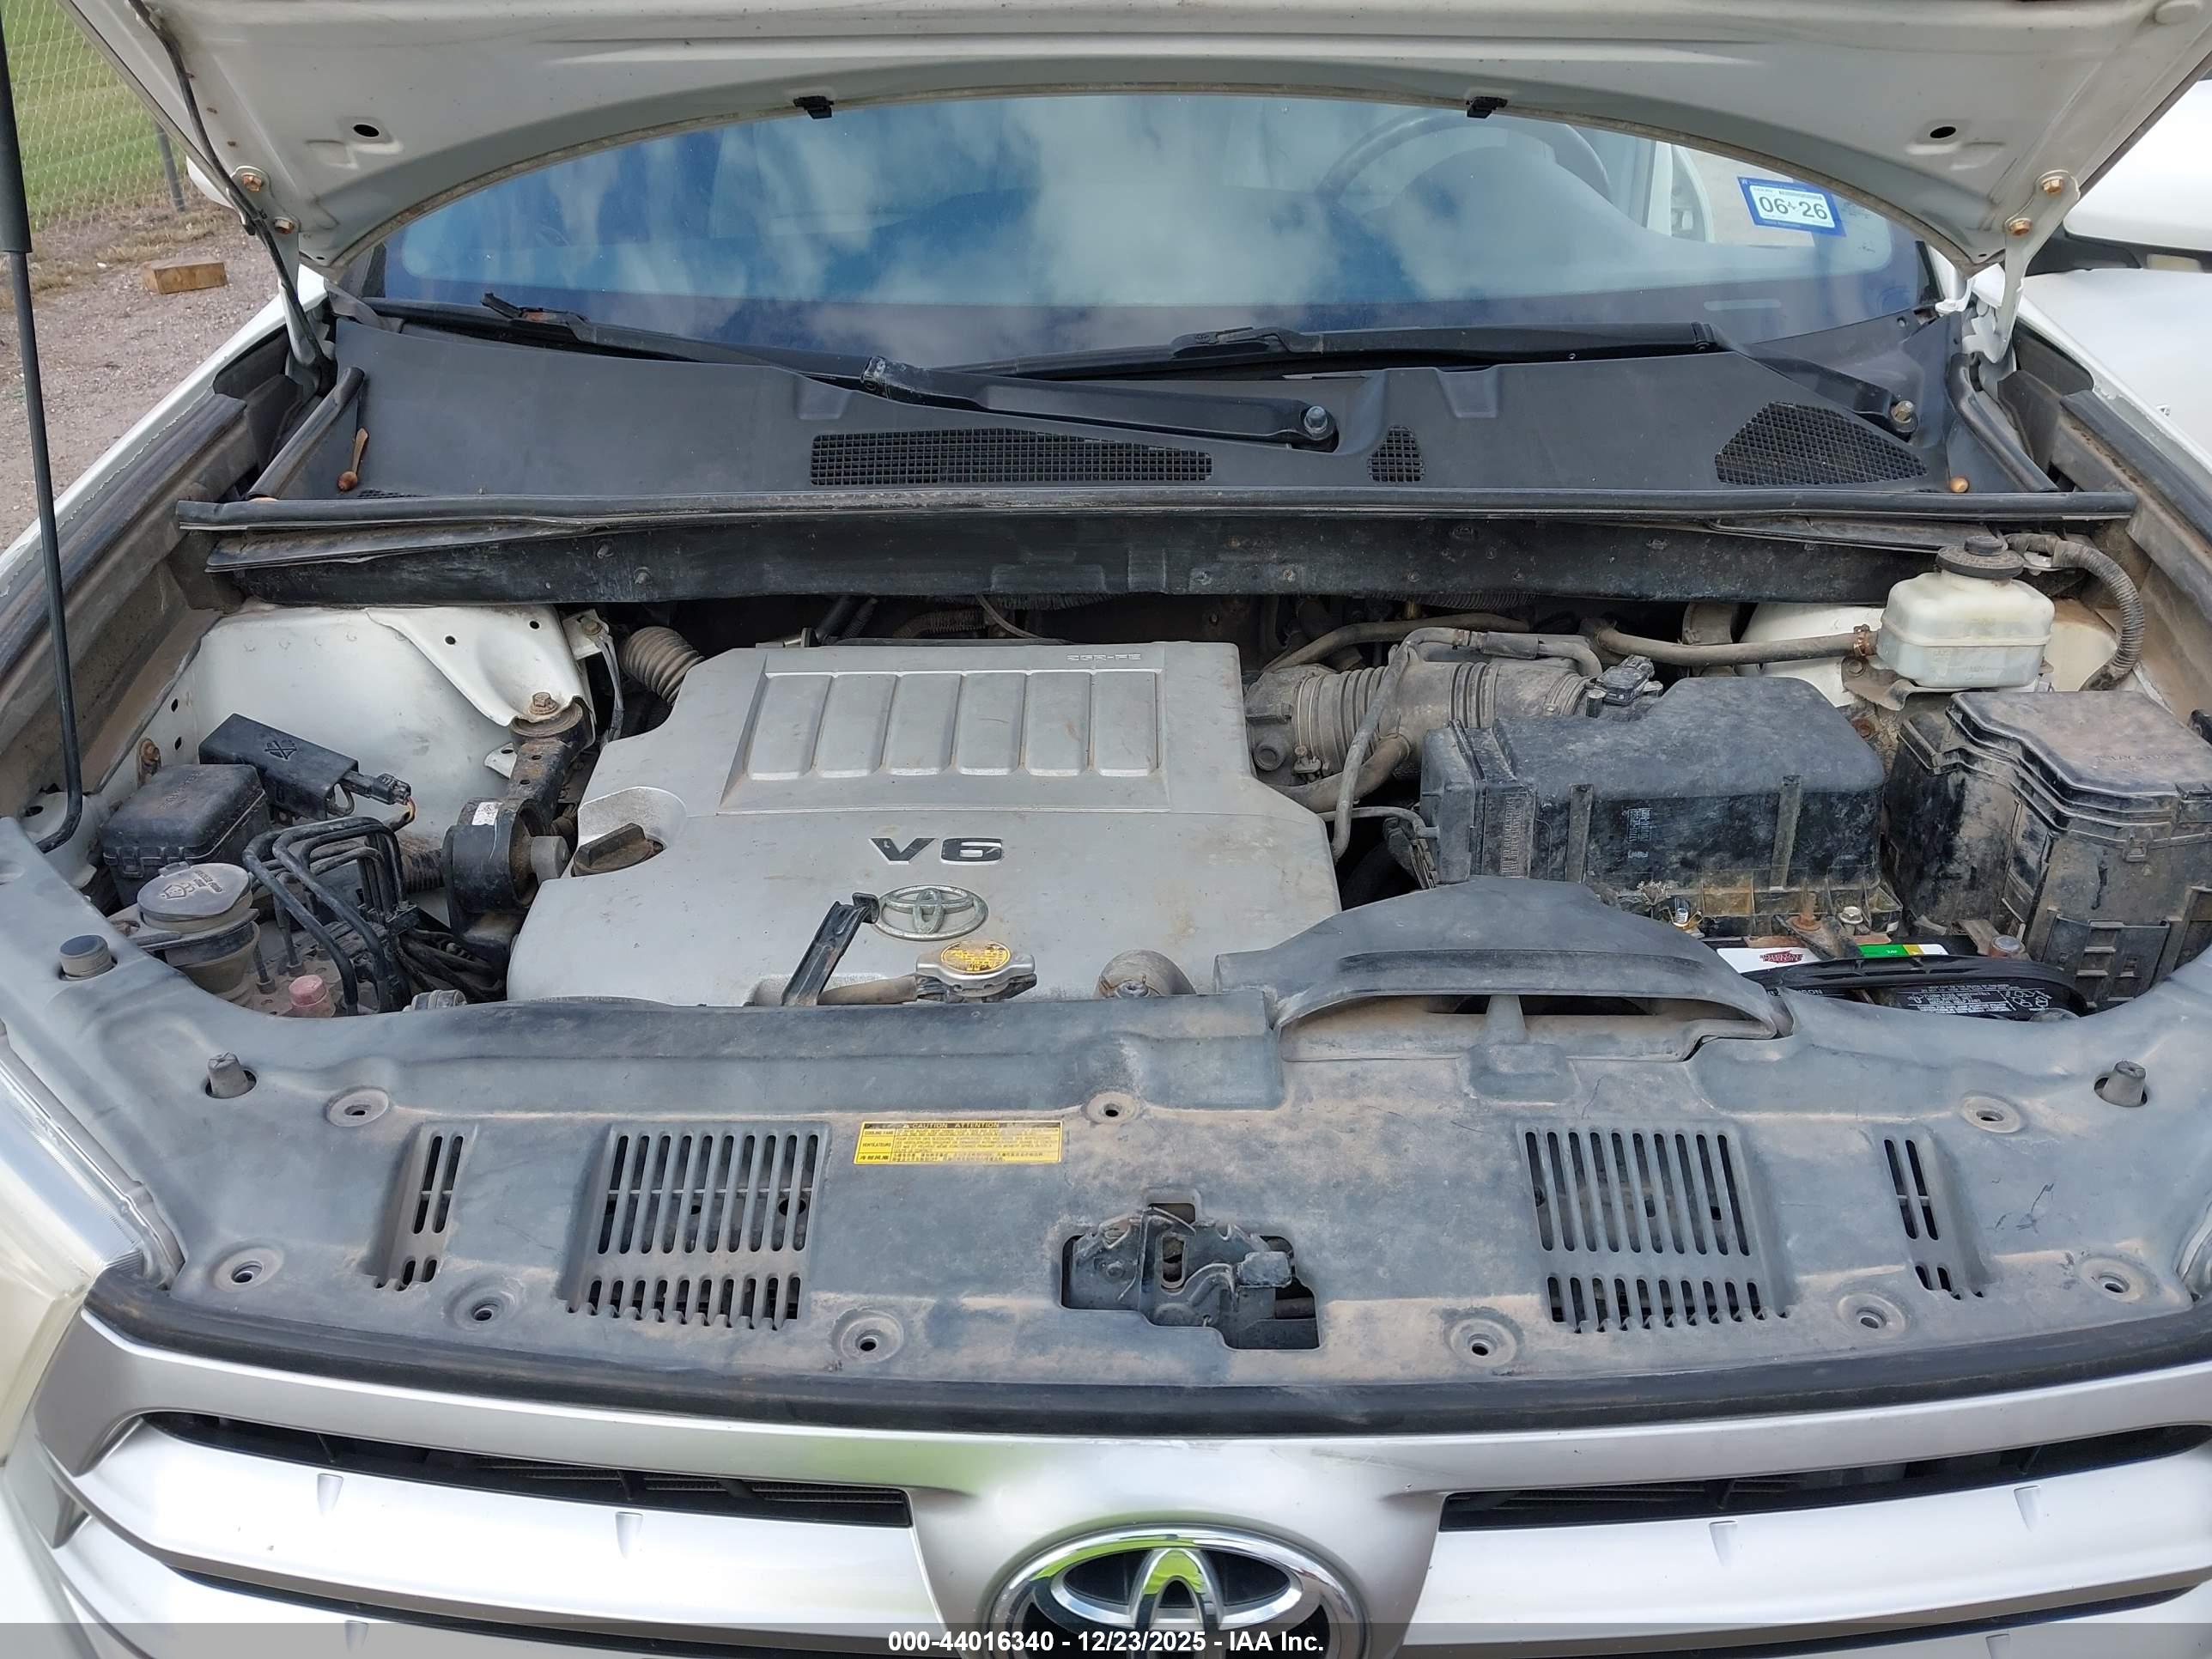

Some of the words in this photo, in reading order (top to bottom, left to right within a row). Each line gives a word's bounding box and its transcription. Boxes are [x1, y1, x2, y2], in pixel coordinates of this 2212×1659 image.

[1759, 196, 1789, 215] 06
[1798, 201, 1828, 220] 26
[868, 836, 1004, 866] V6
